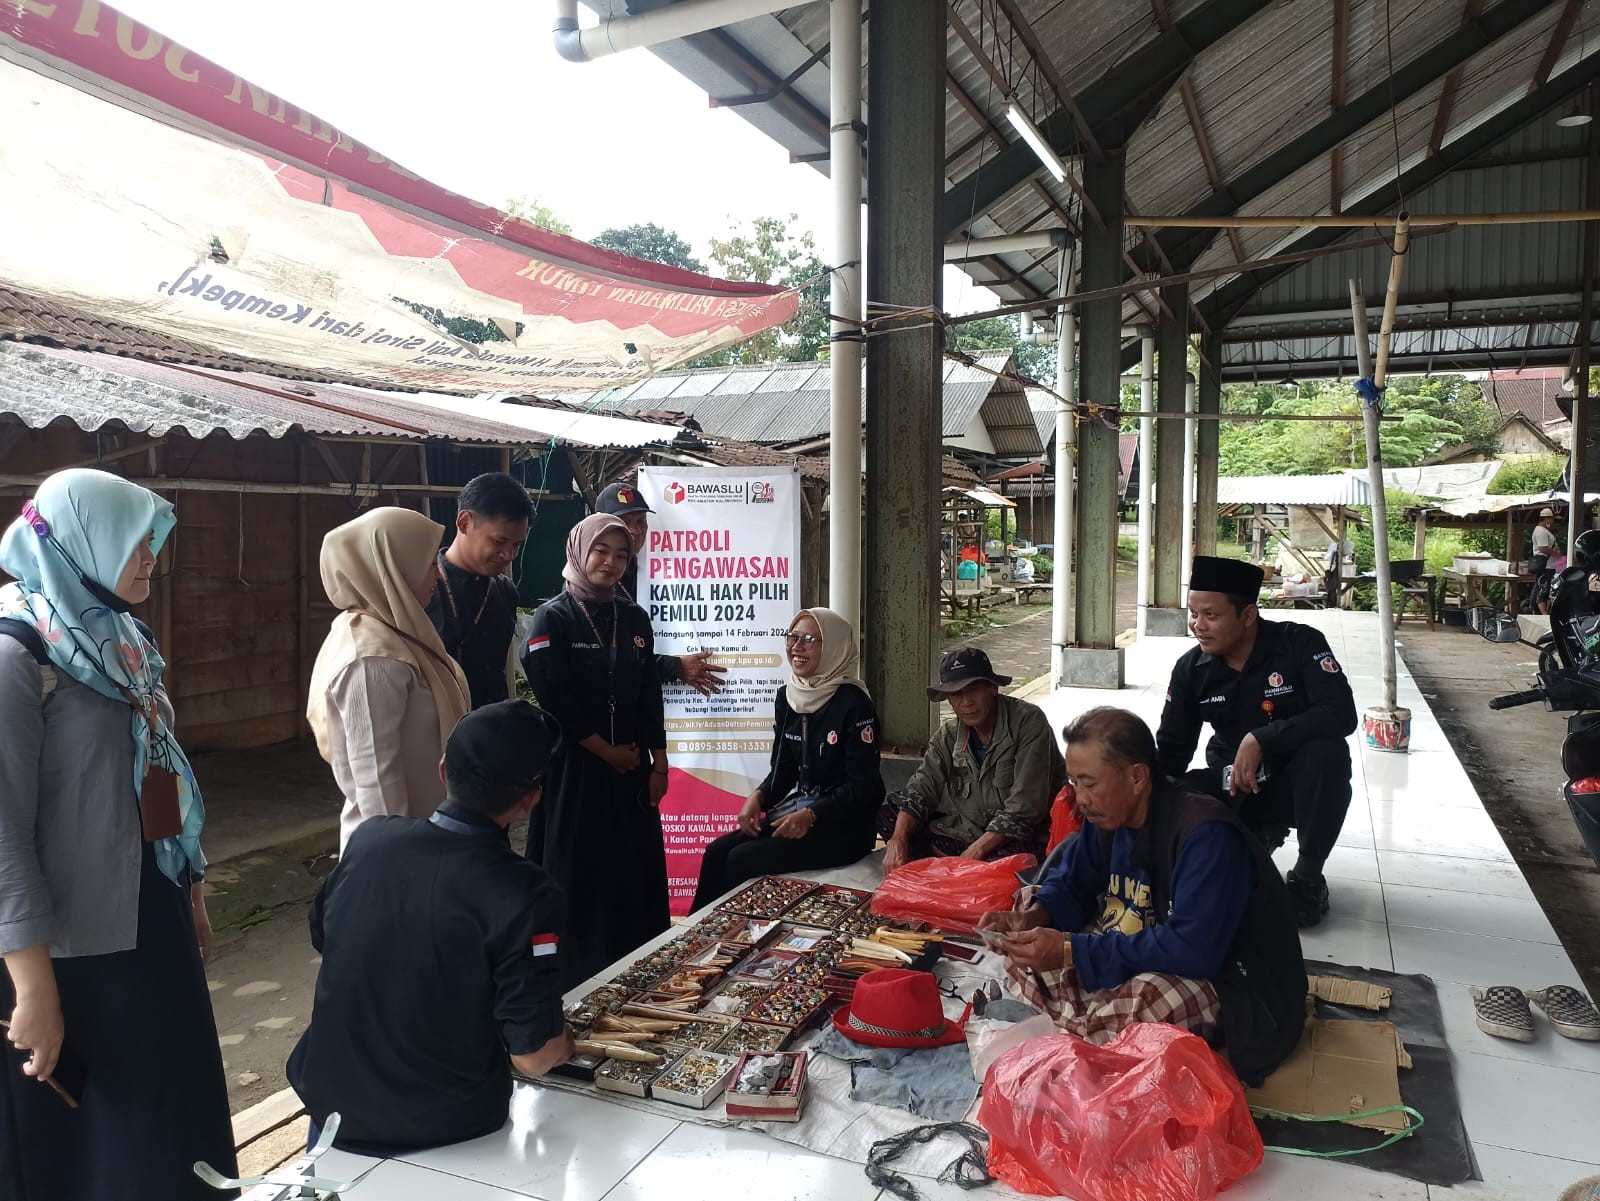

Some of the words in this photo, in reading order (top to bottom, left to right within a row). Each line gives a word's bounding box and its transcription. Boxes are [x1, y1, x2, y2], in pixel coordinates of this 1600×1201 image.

[687, 484, 743, 494] BAWASLU
[650, 530, 730, 552] PATROLI
[649, 556, 789, 579] PENGAWASAN
[650, 583, 705, 601] KAWAL
[710, 583, 743, 601] HAK
[749, 583, 789, 600] PILIH
[650, 604, 708, 621] PEMILU
[714, 604, 756, 621] 2024
[653, 629, 694, 640] erlangsung
[696, 629, 723, 639] sampai
[726, 629, 735, 637] 14
[737, 628, 769, 637] Februari
[686, 645, 699, 653] Cek
[748, 688, 775, 696] Laporkan
[685, 706, 709, 714] hubungi
[660, 813, 679, 822] Atau
[681, 813, 709, 823] datang
[711, 812, 739, 823] langsu
[661, 824, 686, 833] POSKO
[688, 824, 716, 833] KAWAL
[717, 824, 734, 833] HAK
[670, 835, 697, 844] Kantor
[668, 877, 698, 886] BERSAMA
[674, 888, 697, 897] BAWAS
